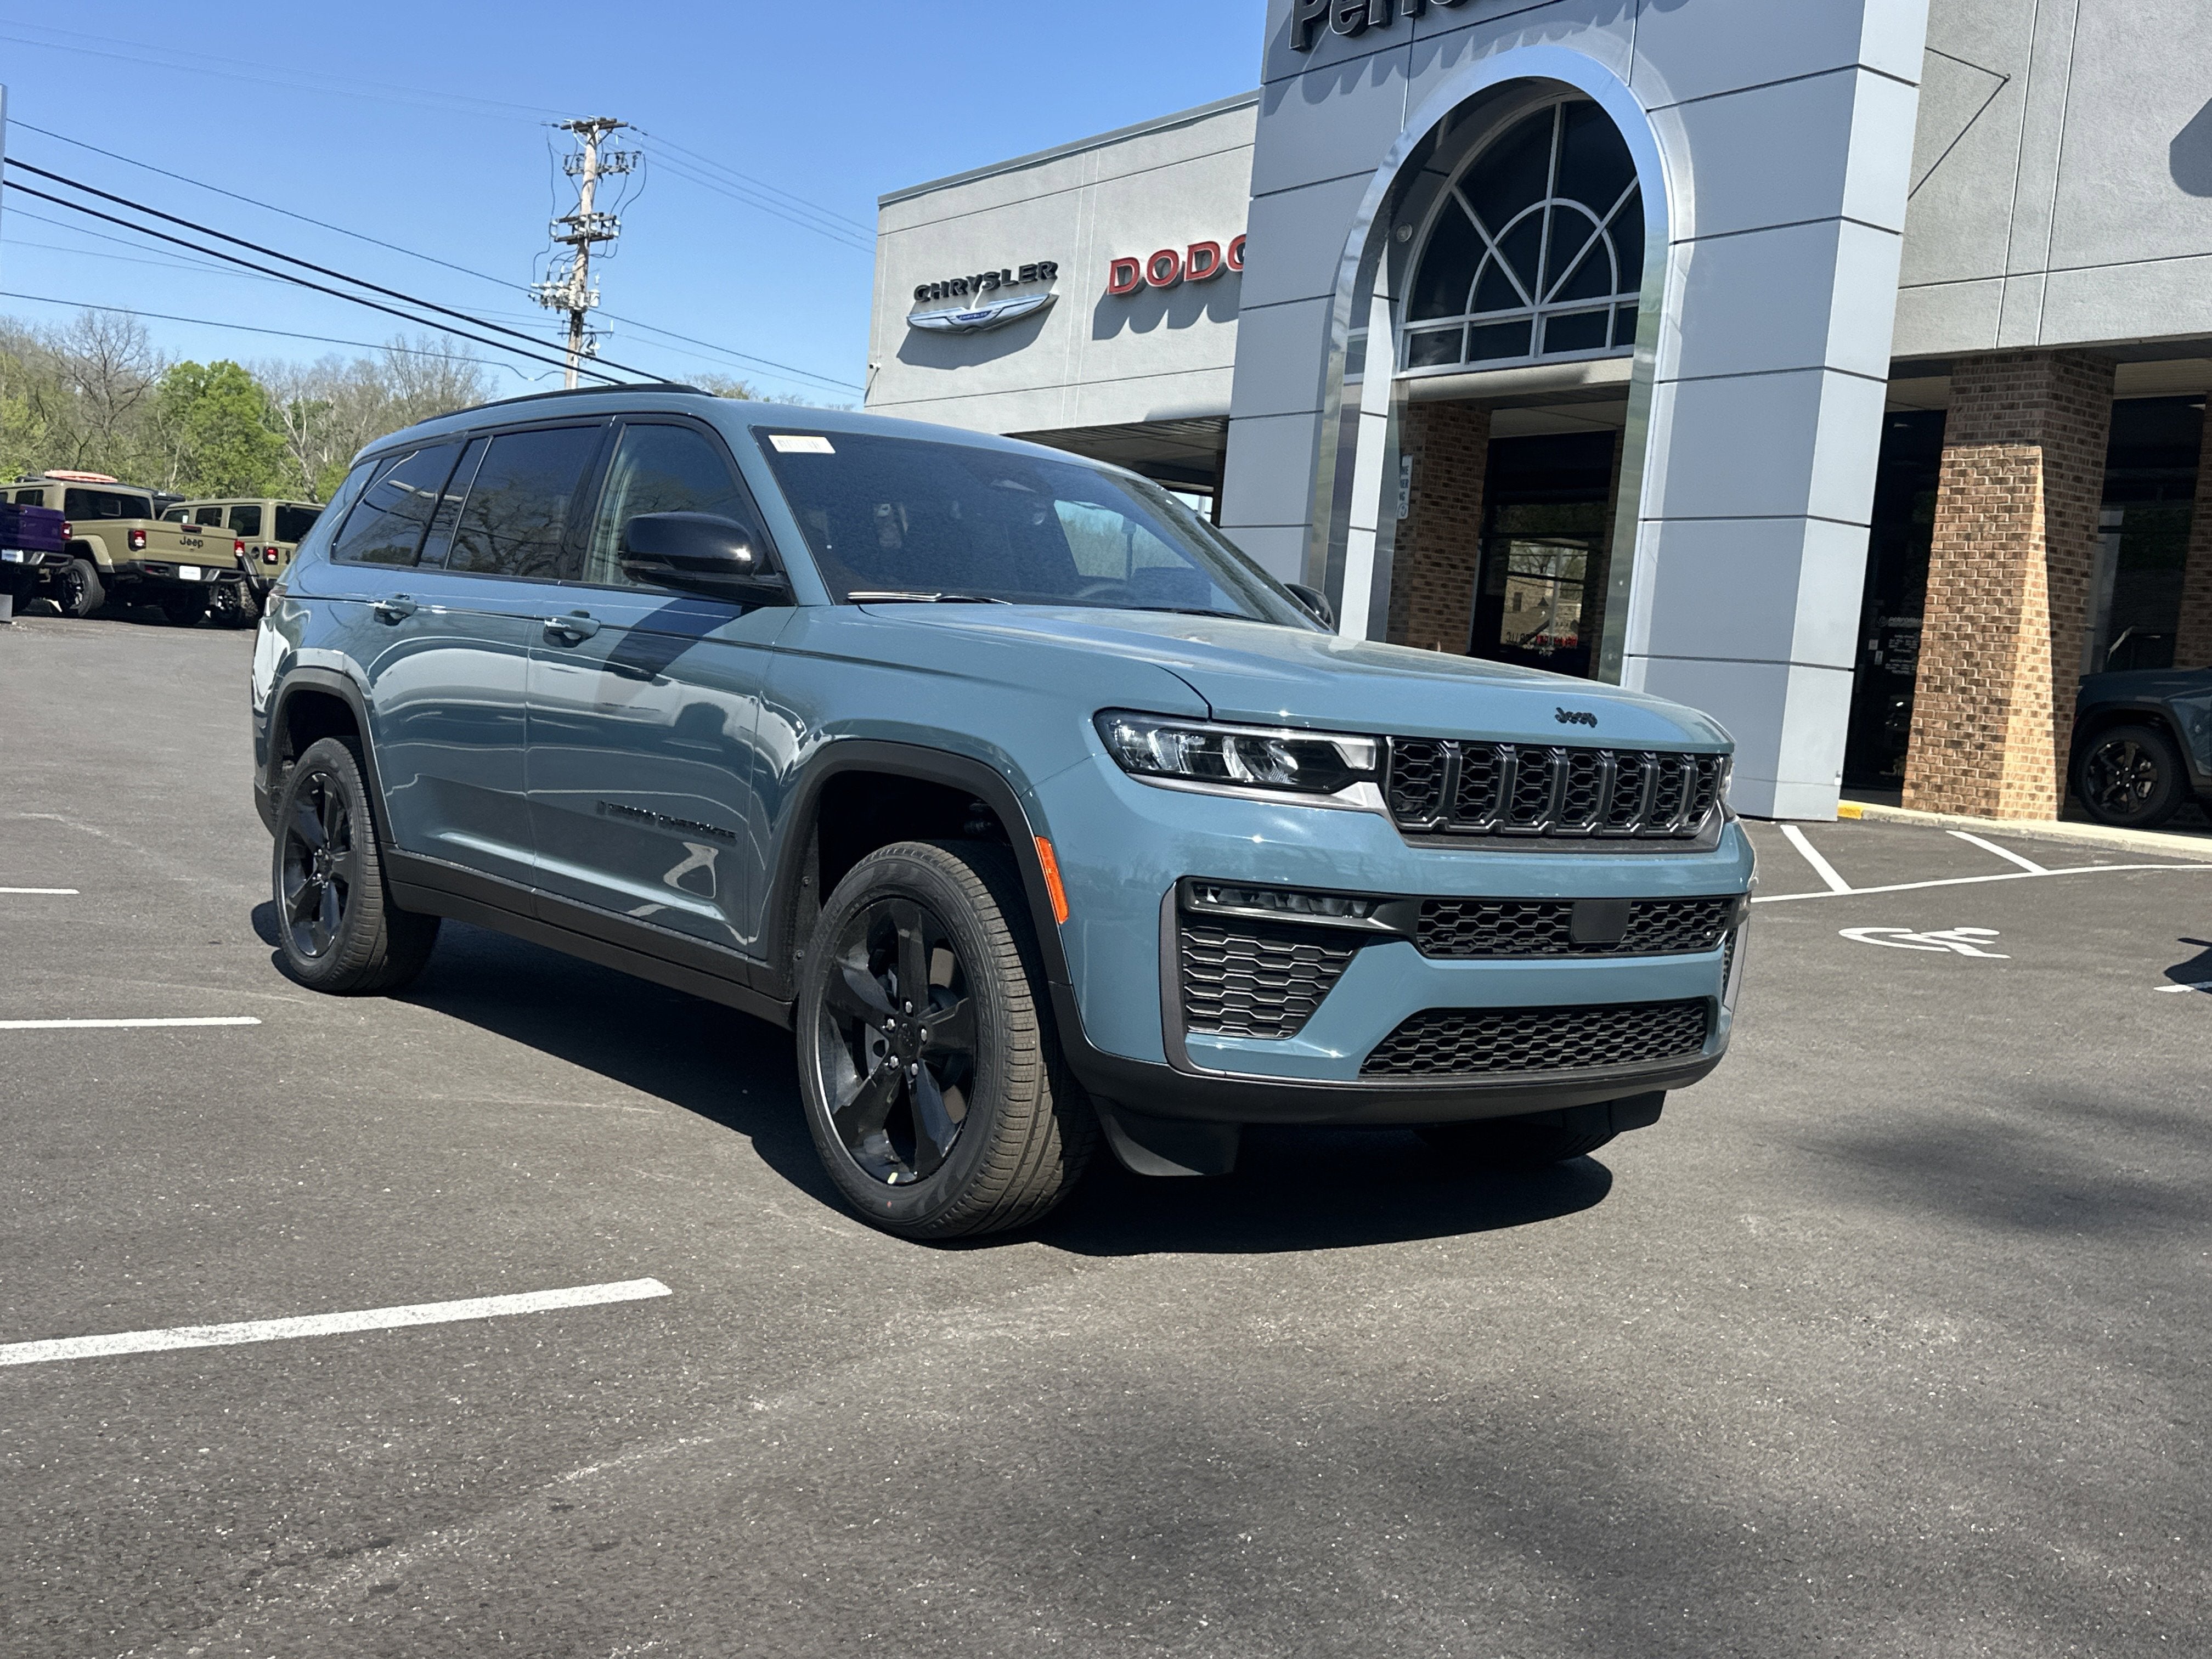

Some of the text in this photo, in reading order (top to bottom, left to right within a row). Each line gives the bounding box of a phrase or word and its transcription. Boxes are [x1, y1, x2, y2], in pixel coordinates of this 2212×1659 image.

[914, 261, 1058, 302] CHRYSLER
[179, 535, 204, 549] Jeep
[1555, 707, 1598, 728] Jeep
